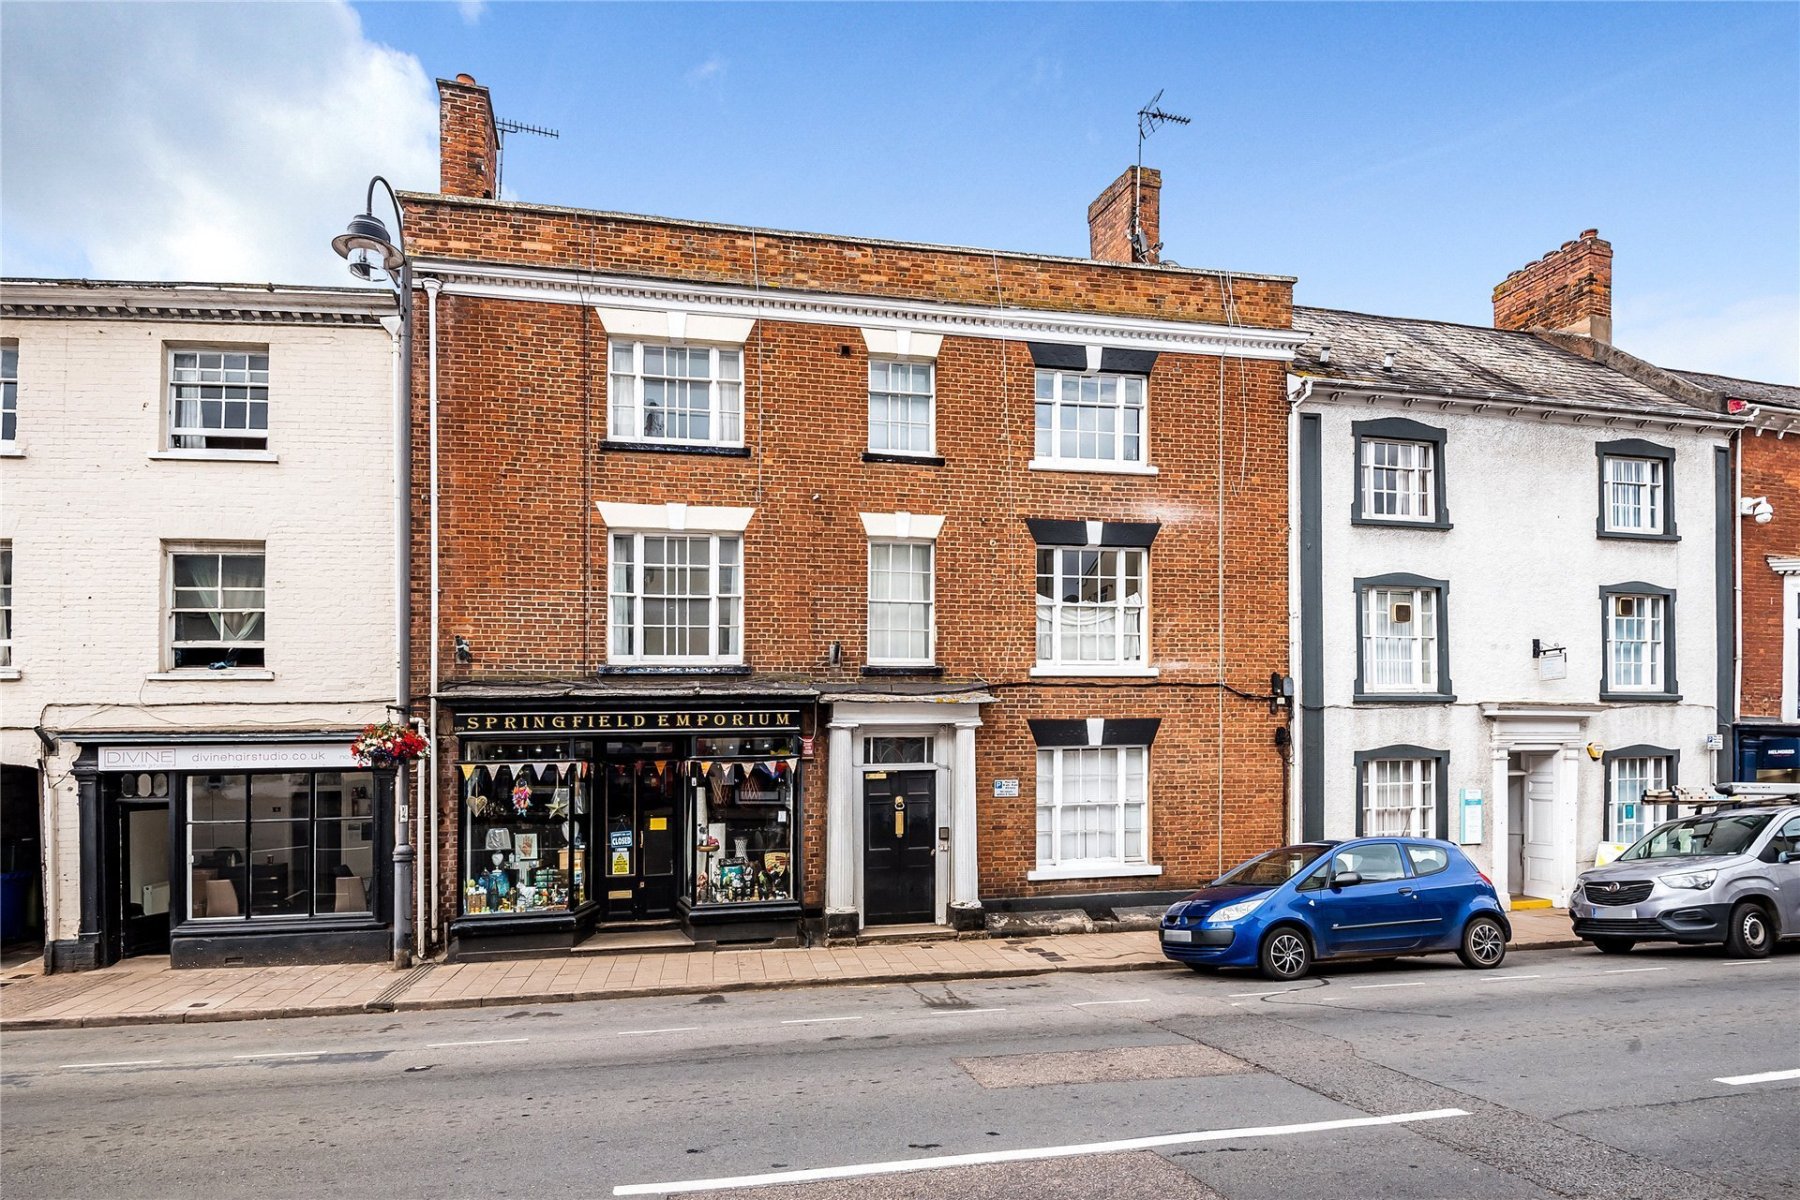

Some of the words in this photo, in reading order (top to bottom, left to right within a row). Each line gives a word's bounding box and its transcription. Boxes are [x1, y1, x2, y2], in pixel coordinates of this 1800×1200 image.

[467, 715, 646, 730] SPRINGFIELD
[658, 713, 791, 727] EMPORIUM
[107, 751, 173, 764] DIVINE
[191, 751, 326, 762] divinehairstudio.co.uk
[612, 836, 632, 846] CLOSED
